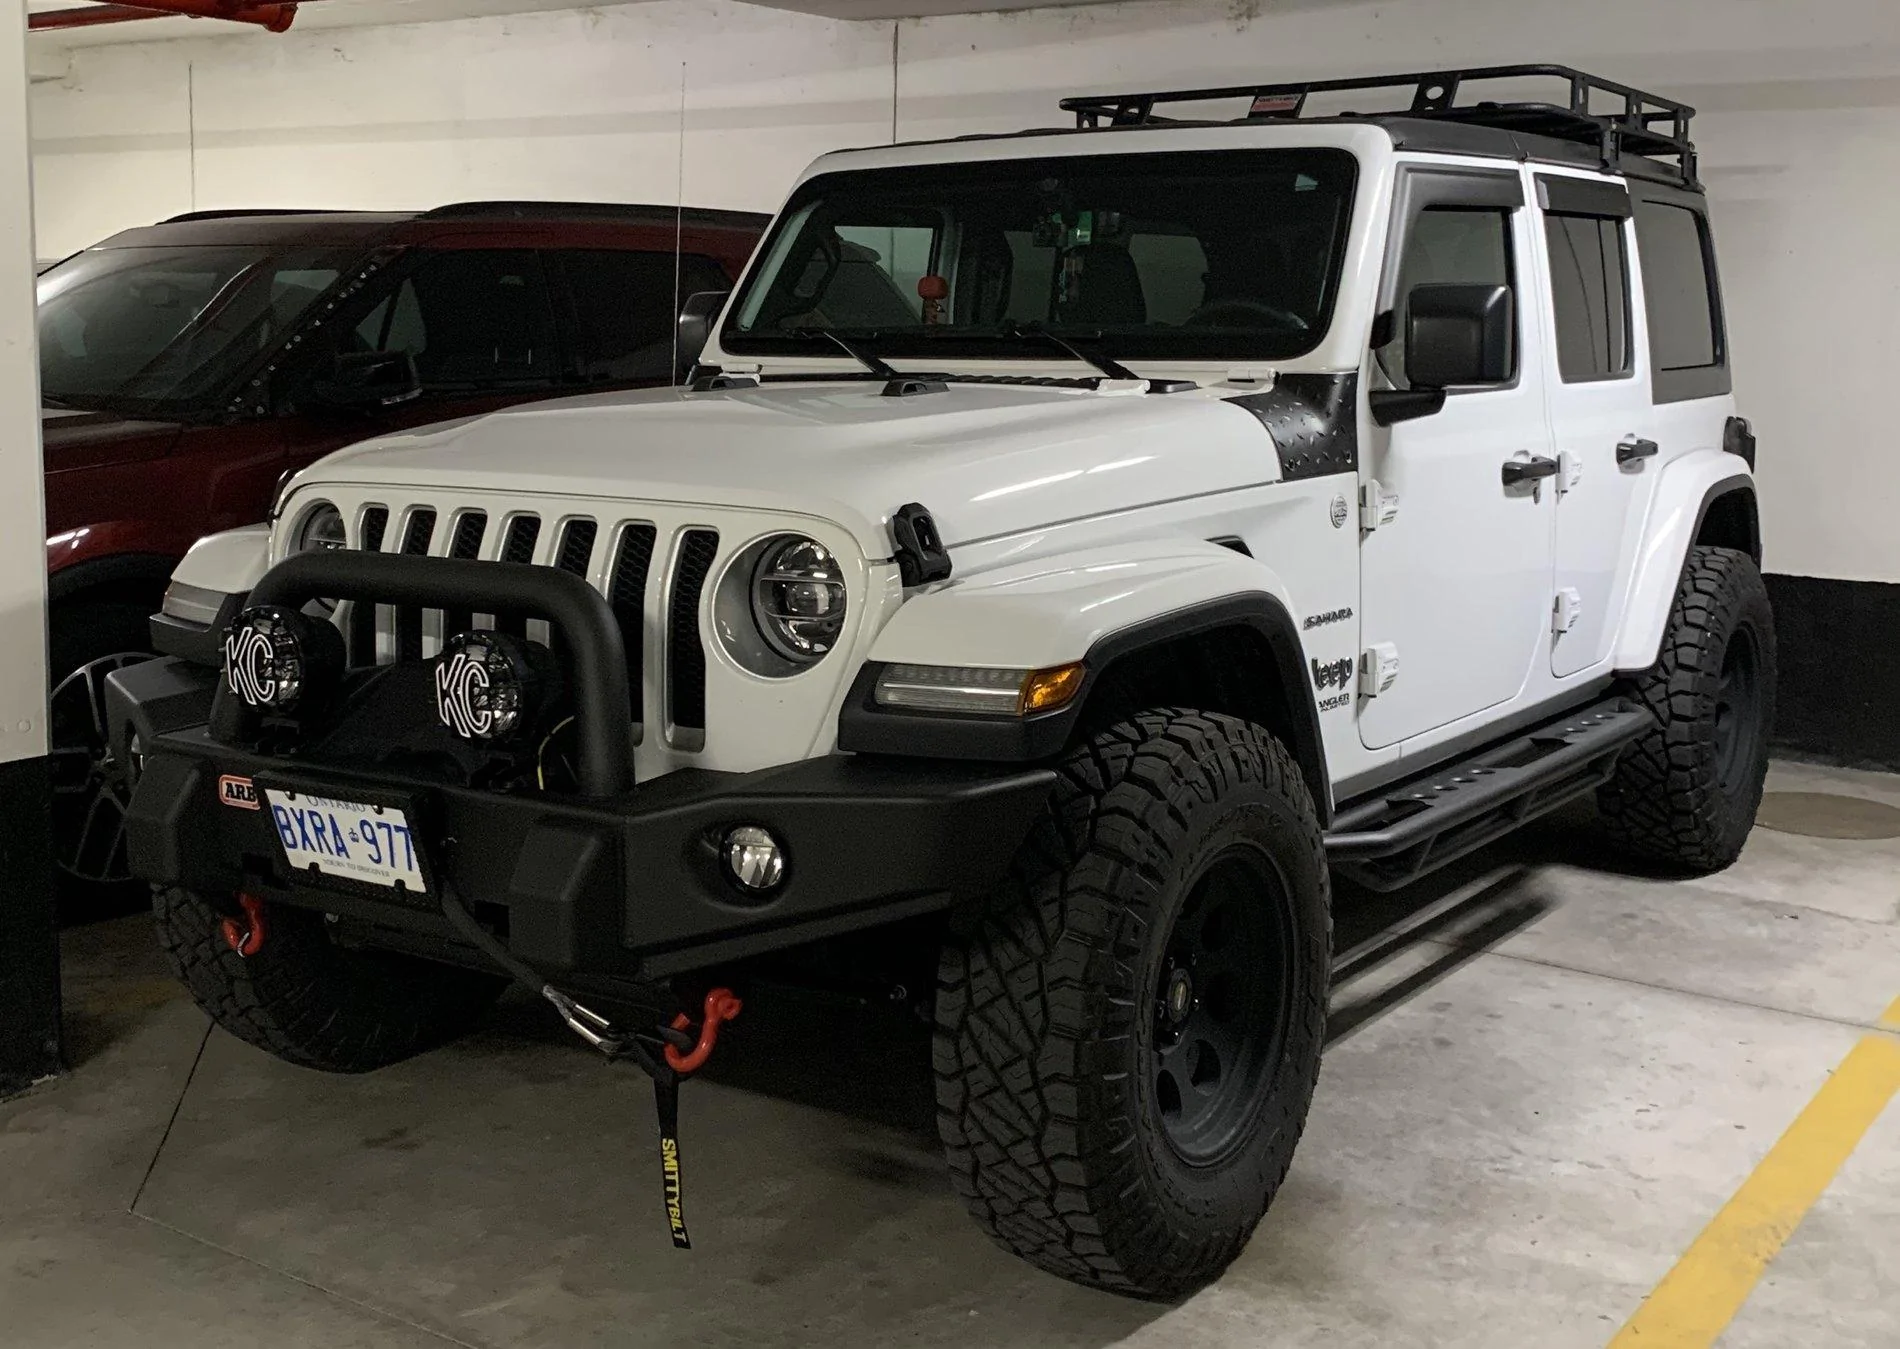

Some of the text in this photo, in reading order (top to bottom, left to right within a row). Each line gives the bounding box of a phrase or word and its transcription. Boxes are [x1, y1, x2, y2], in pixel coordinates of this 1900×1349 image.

[1303, 607, 1353, 630] SAHARA
[226, 627, 276, 705] KC
[435, 653, 492, 738] KC
[1311, 657, 1353, 691] Jeep
[662, 1138, 687, 1243] SMITTYBILT
